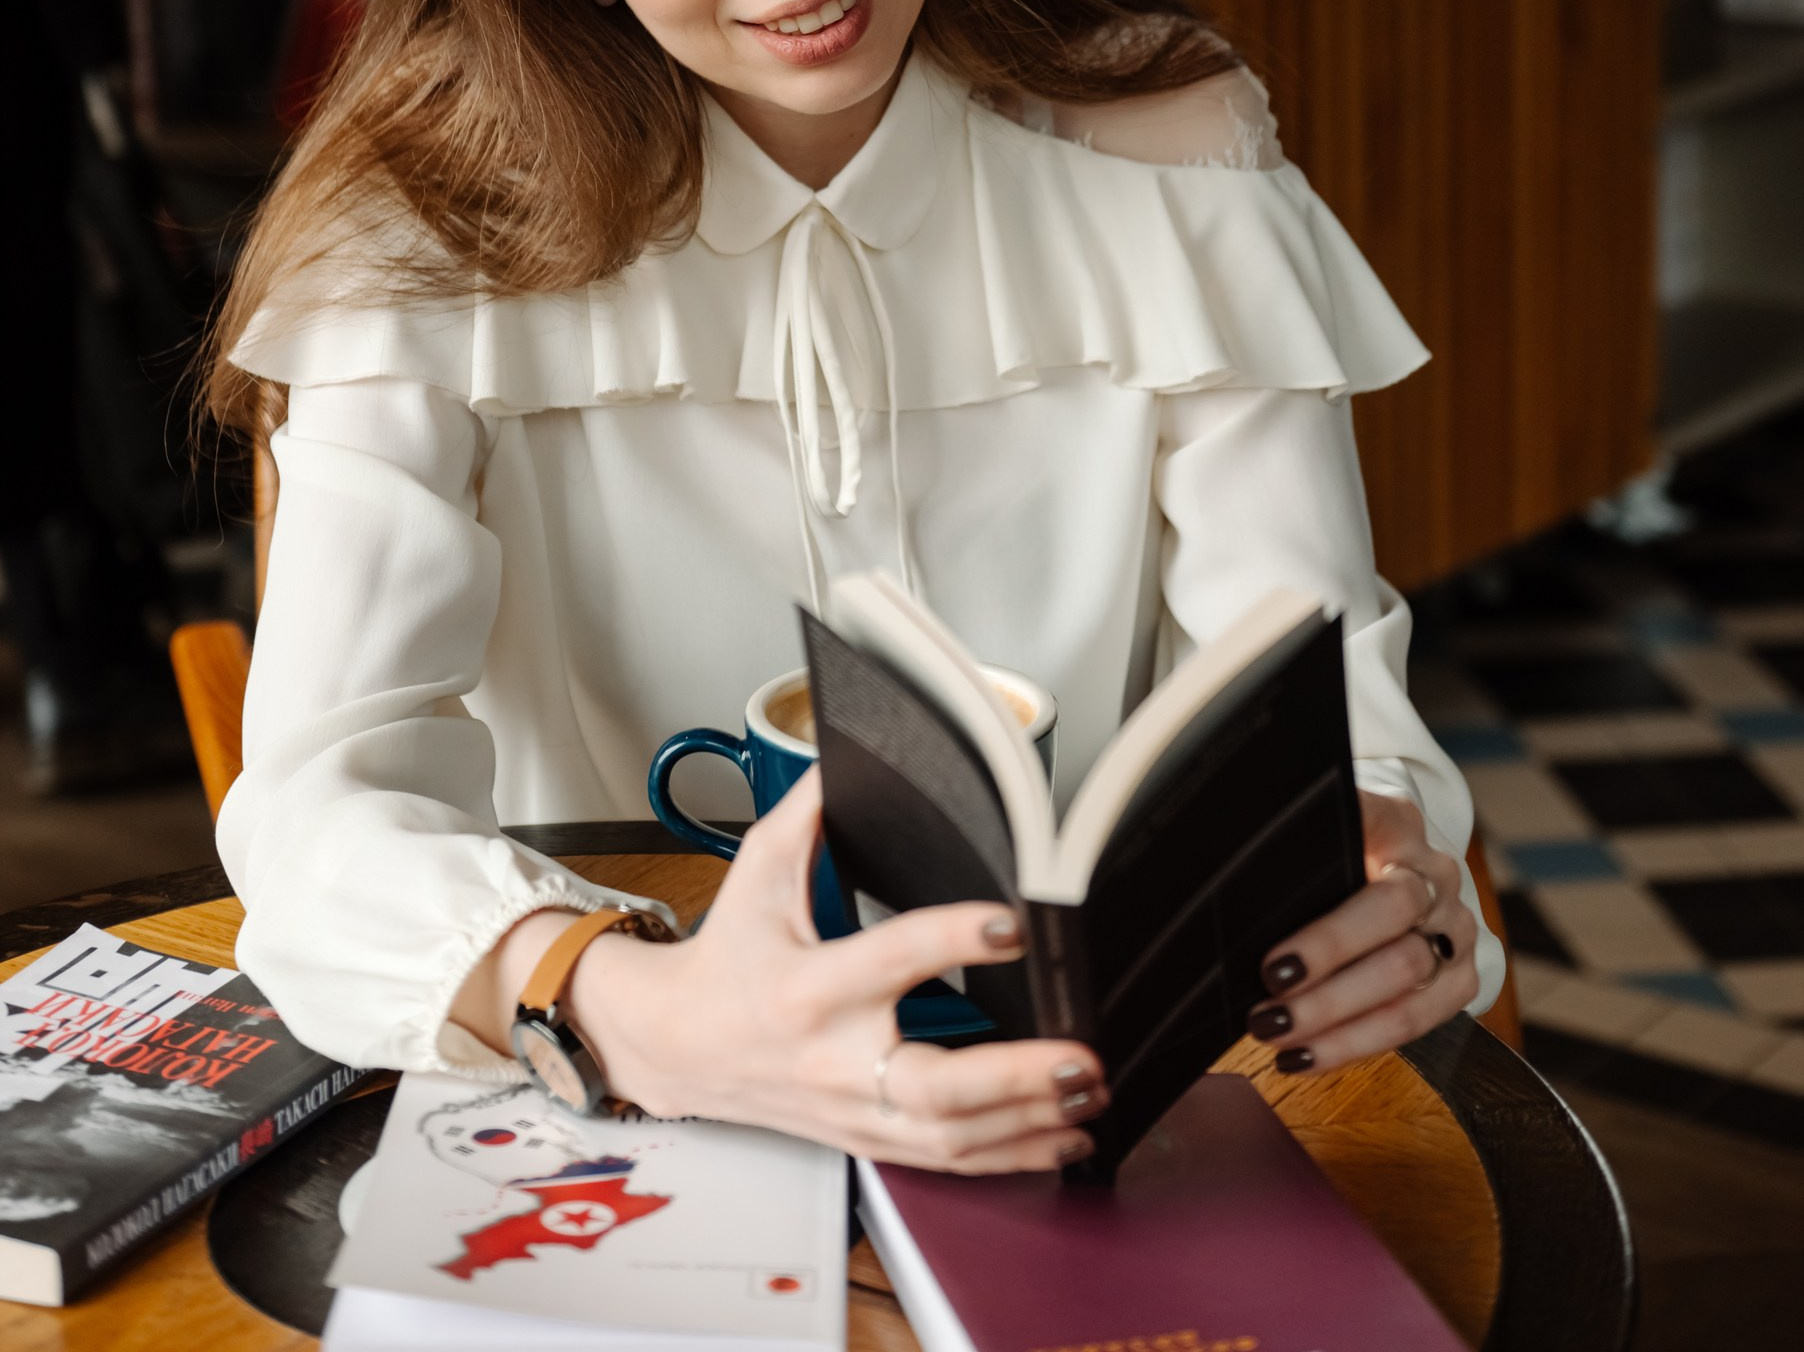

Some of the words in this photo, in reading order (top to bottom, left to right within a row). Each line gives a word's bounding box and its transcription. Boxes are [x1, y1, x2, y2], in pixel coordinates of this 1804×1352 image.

[14, 1019, 244, 1088] КОЛОКОЛ
[24, 990, 279, 1064] НАГАСАКИ
[275, 1079, 328, 1135] ТАКАСИ
